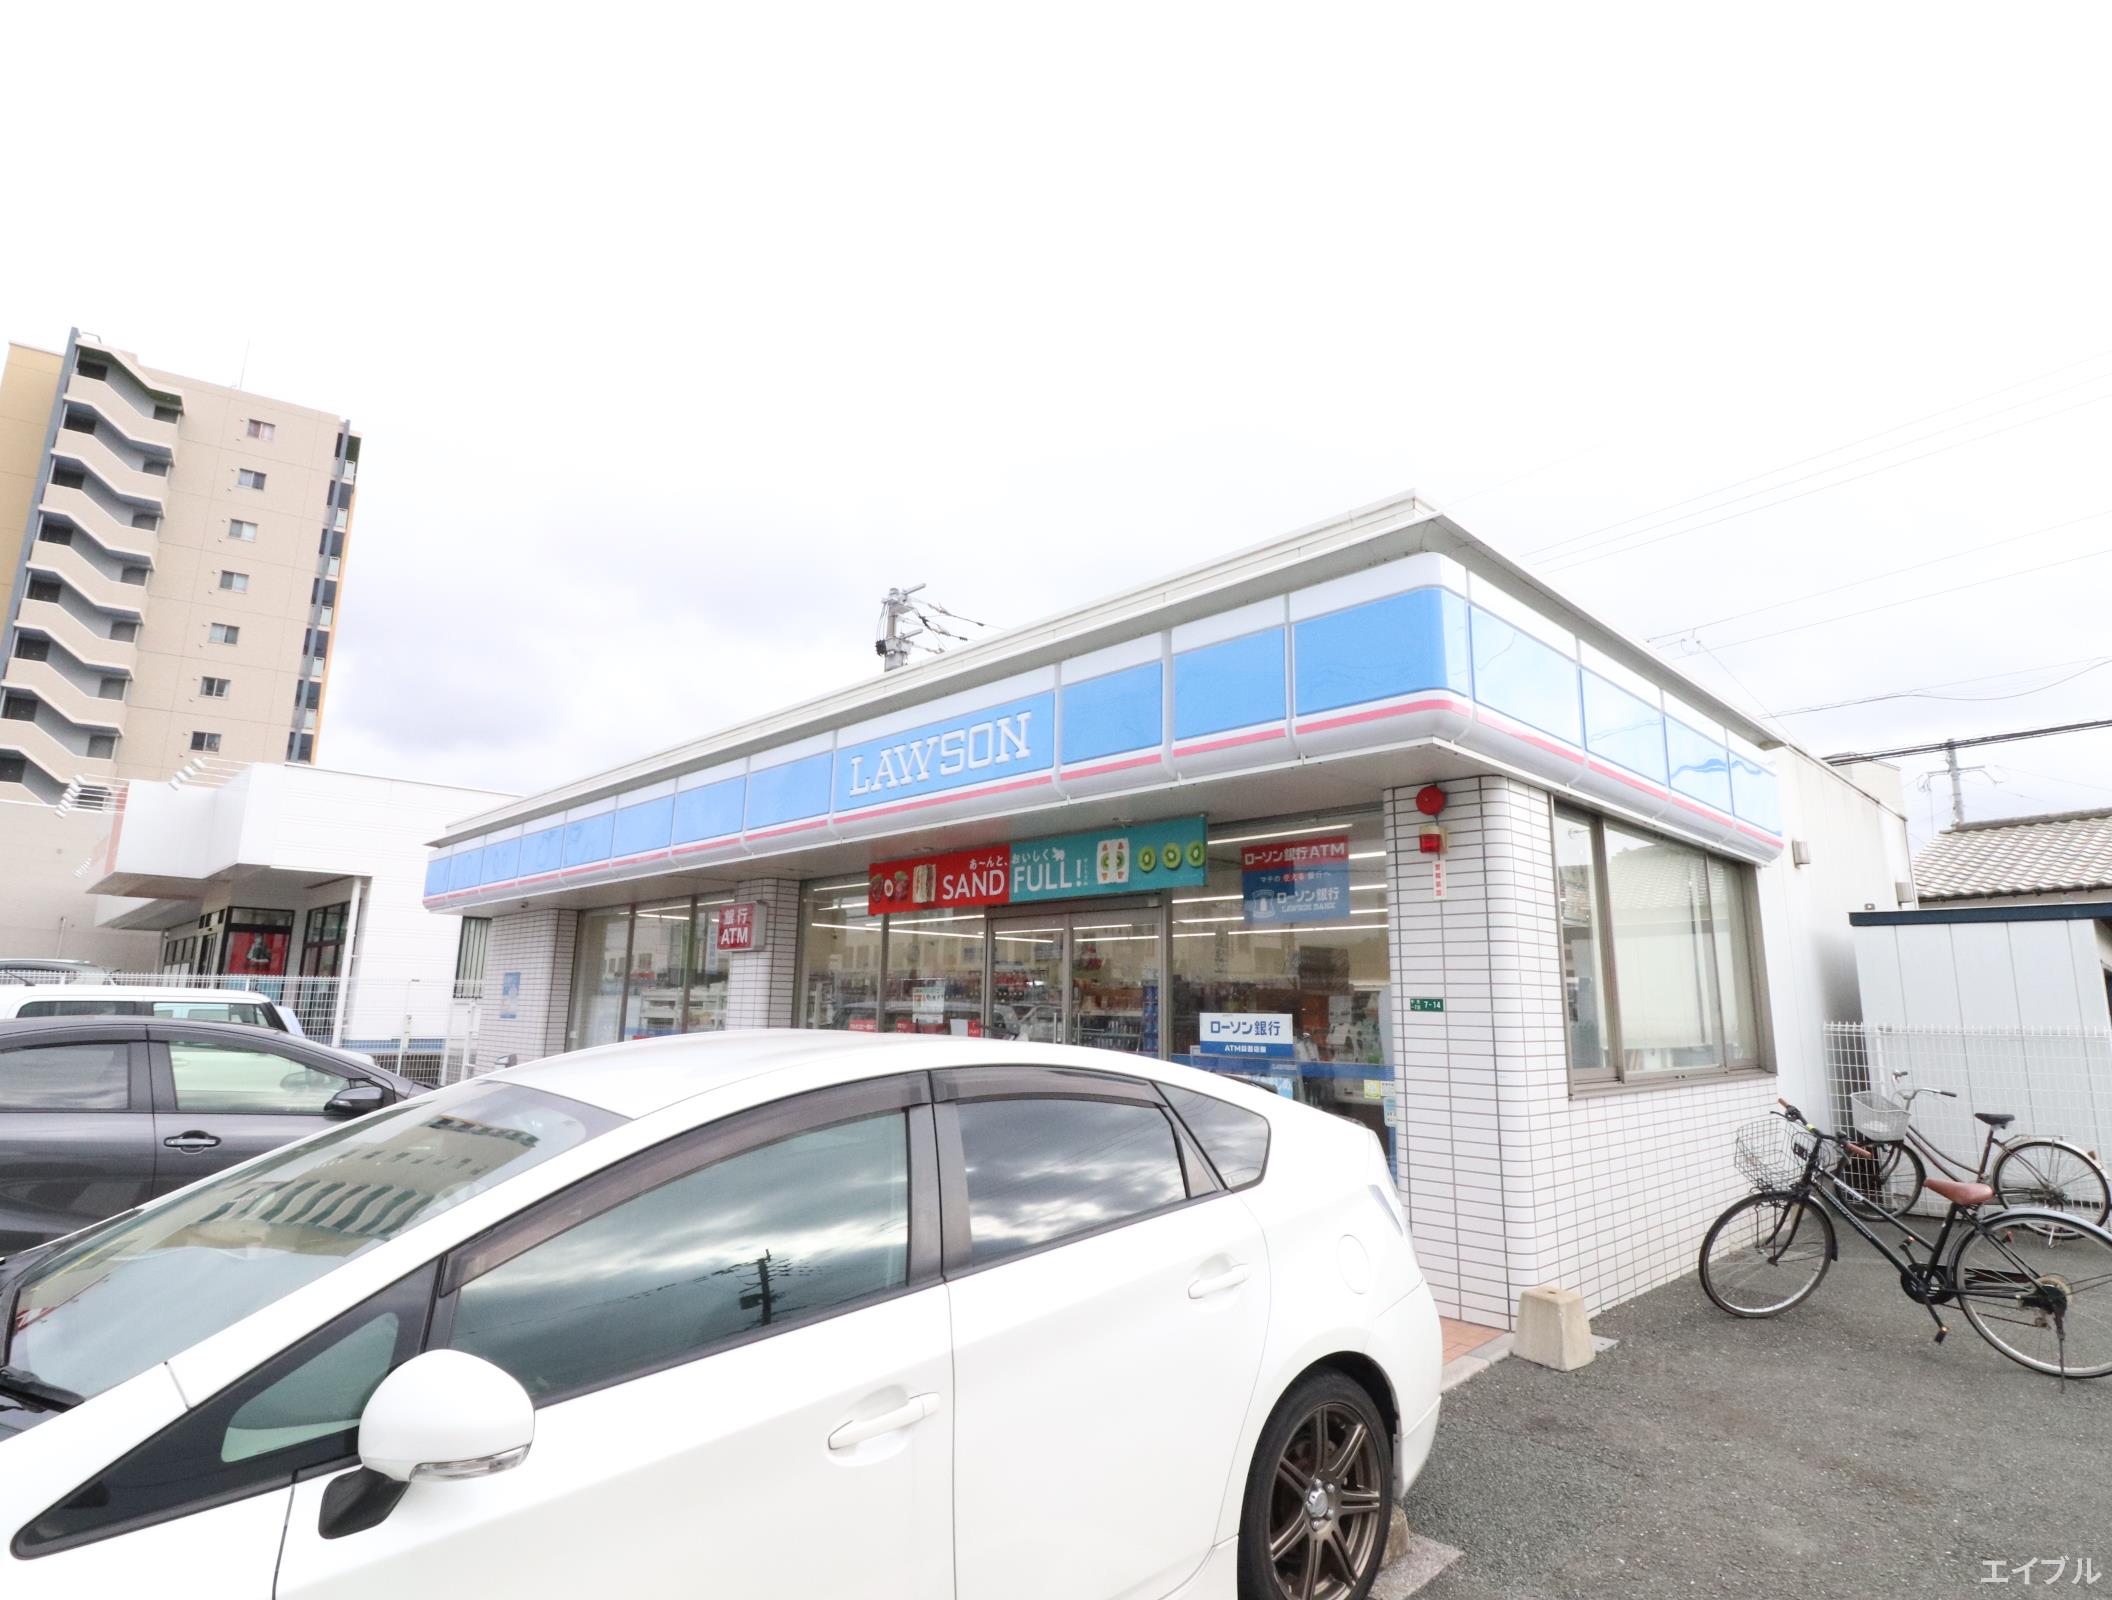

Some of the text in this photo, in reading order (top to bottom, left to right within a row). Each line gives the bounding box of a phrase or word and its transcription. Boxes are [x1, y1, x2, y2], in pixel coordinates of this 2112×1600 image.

[850, 711, 1032, 796] LAWSON
[1011, 848, 1049, 864] おいしく
[1244, 842, 1346, 866] ローソン銀行ATM
[942, 869, 1005, 900] SAND
[1013, 858, 1082, 894] FULL!
[1276, 887, 1340, 904] ローソン銀行
[724, 908, 748, 925] 銀行
[720, 927, 749, 945] ATM
[1423, 1000, 1441, 1009] 7-14
[1210, 1020, 1281, 1037] ローソン銀行
